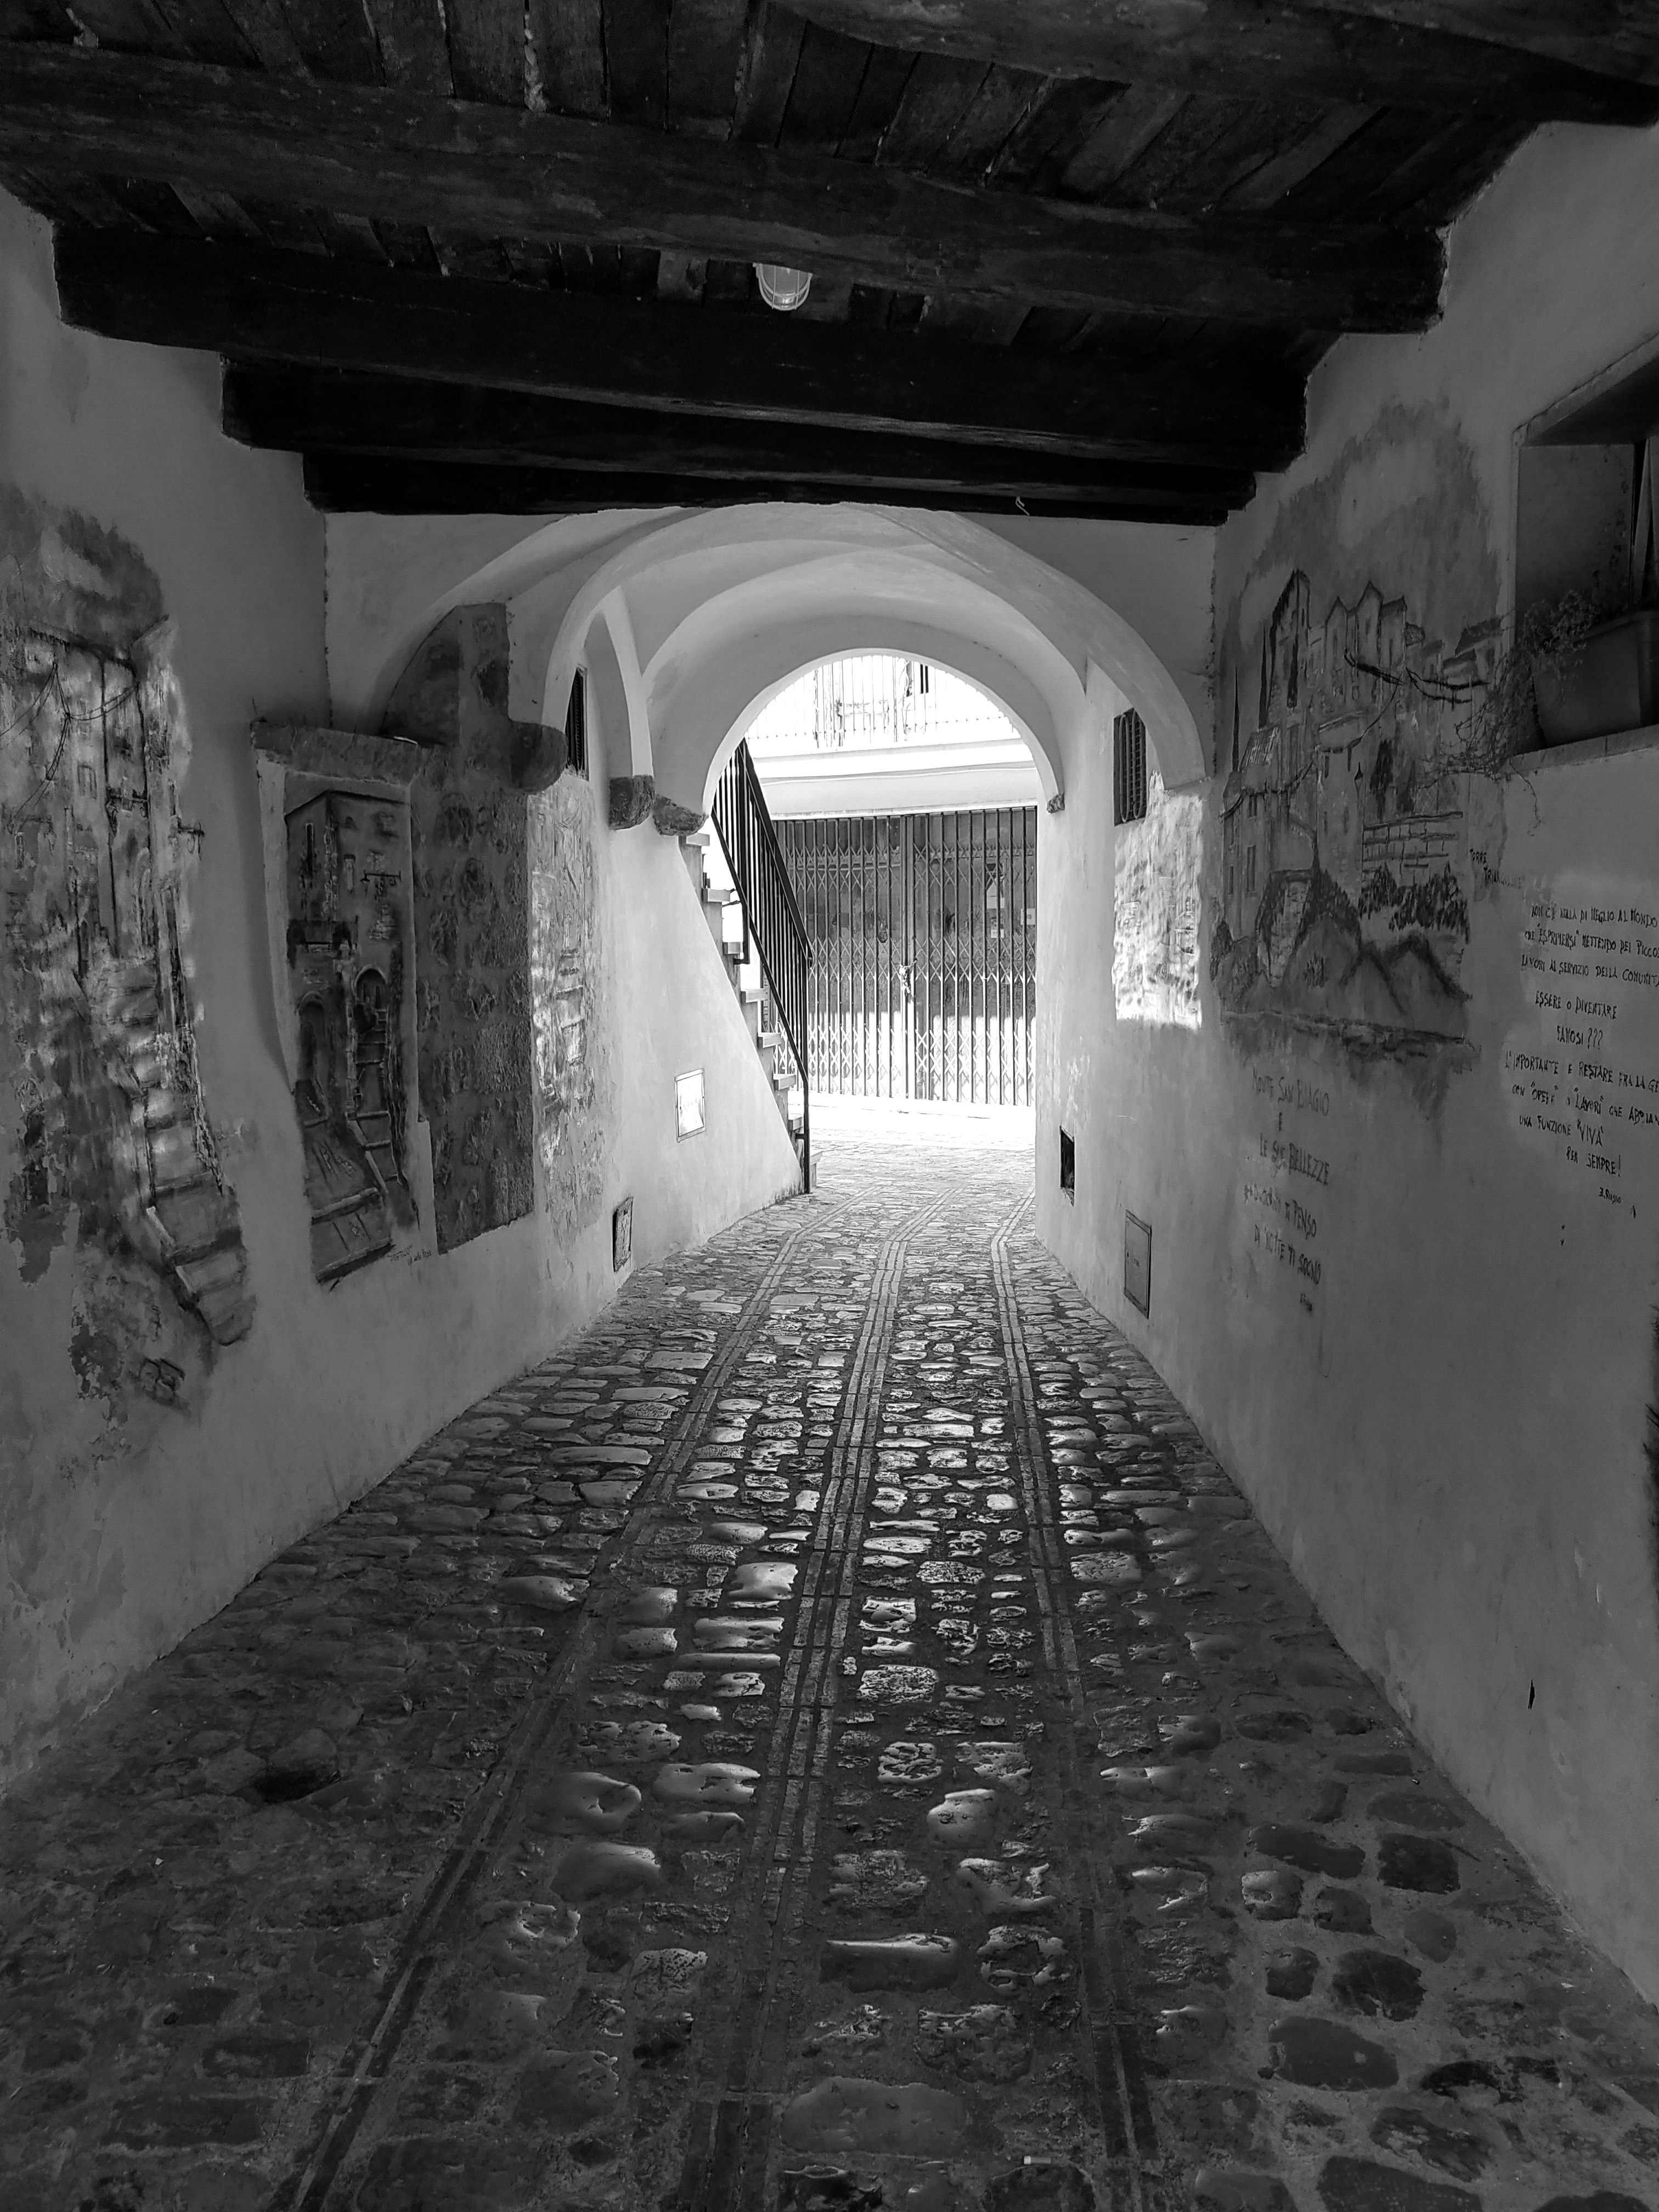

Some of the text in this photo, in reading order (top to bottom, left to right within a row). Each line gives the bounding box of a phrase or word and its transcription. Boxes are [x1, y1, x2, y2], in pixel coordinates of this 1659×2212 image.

[1531, 906, 1543, 918] NON
[1560, 908, 1577, 920] NULLA
[1579, 909, 1587, 923] DI
[1591, 907, 1615, 924] MEGLIO
[1618, 909, 1628, 922] AL
[1630, 908, 1658, 928] MONDO
[1582, 934, 1616, 953] METTENDO
[1620, 939, 1631, 954] DEI
[1521, 954, 1545, 972] LAVORI
[1559, 962, 1589, 977] SERVIZIO
[1595, 966, 1617, 978] DELLA
[1536, 991, 1561, 1009] ESSERE
[1575, 996, 1617, 1020] DIVENTARE
[1557, 1025, 1584, 1045] FAMOSI
[1579, 1061, 1613, 1084] RESTARE
[1618, 1071, 1633, 1087] FRA
[1635, 1075, 1645, 1090] LA
[1513, 1084, 1525, 1097] CON
[1609, 1105, 1623, 1118] CHE
[1519, 1115, 1532, 1128] UNA
[1537, 1115, 1571, 1136] FUNZIONE
[1289, 1142, 1329, 1187] BELLEZZE
[1566, 1146, 1578, 1164] PER
[1293, 1200, 1317, 1240] PENSO
[1297, 1254, 1321, 1285] SOGNO
